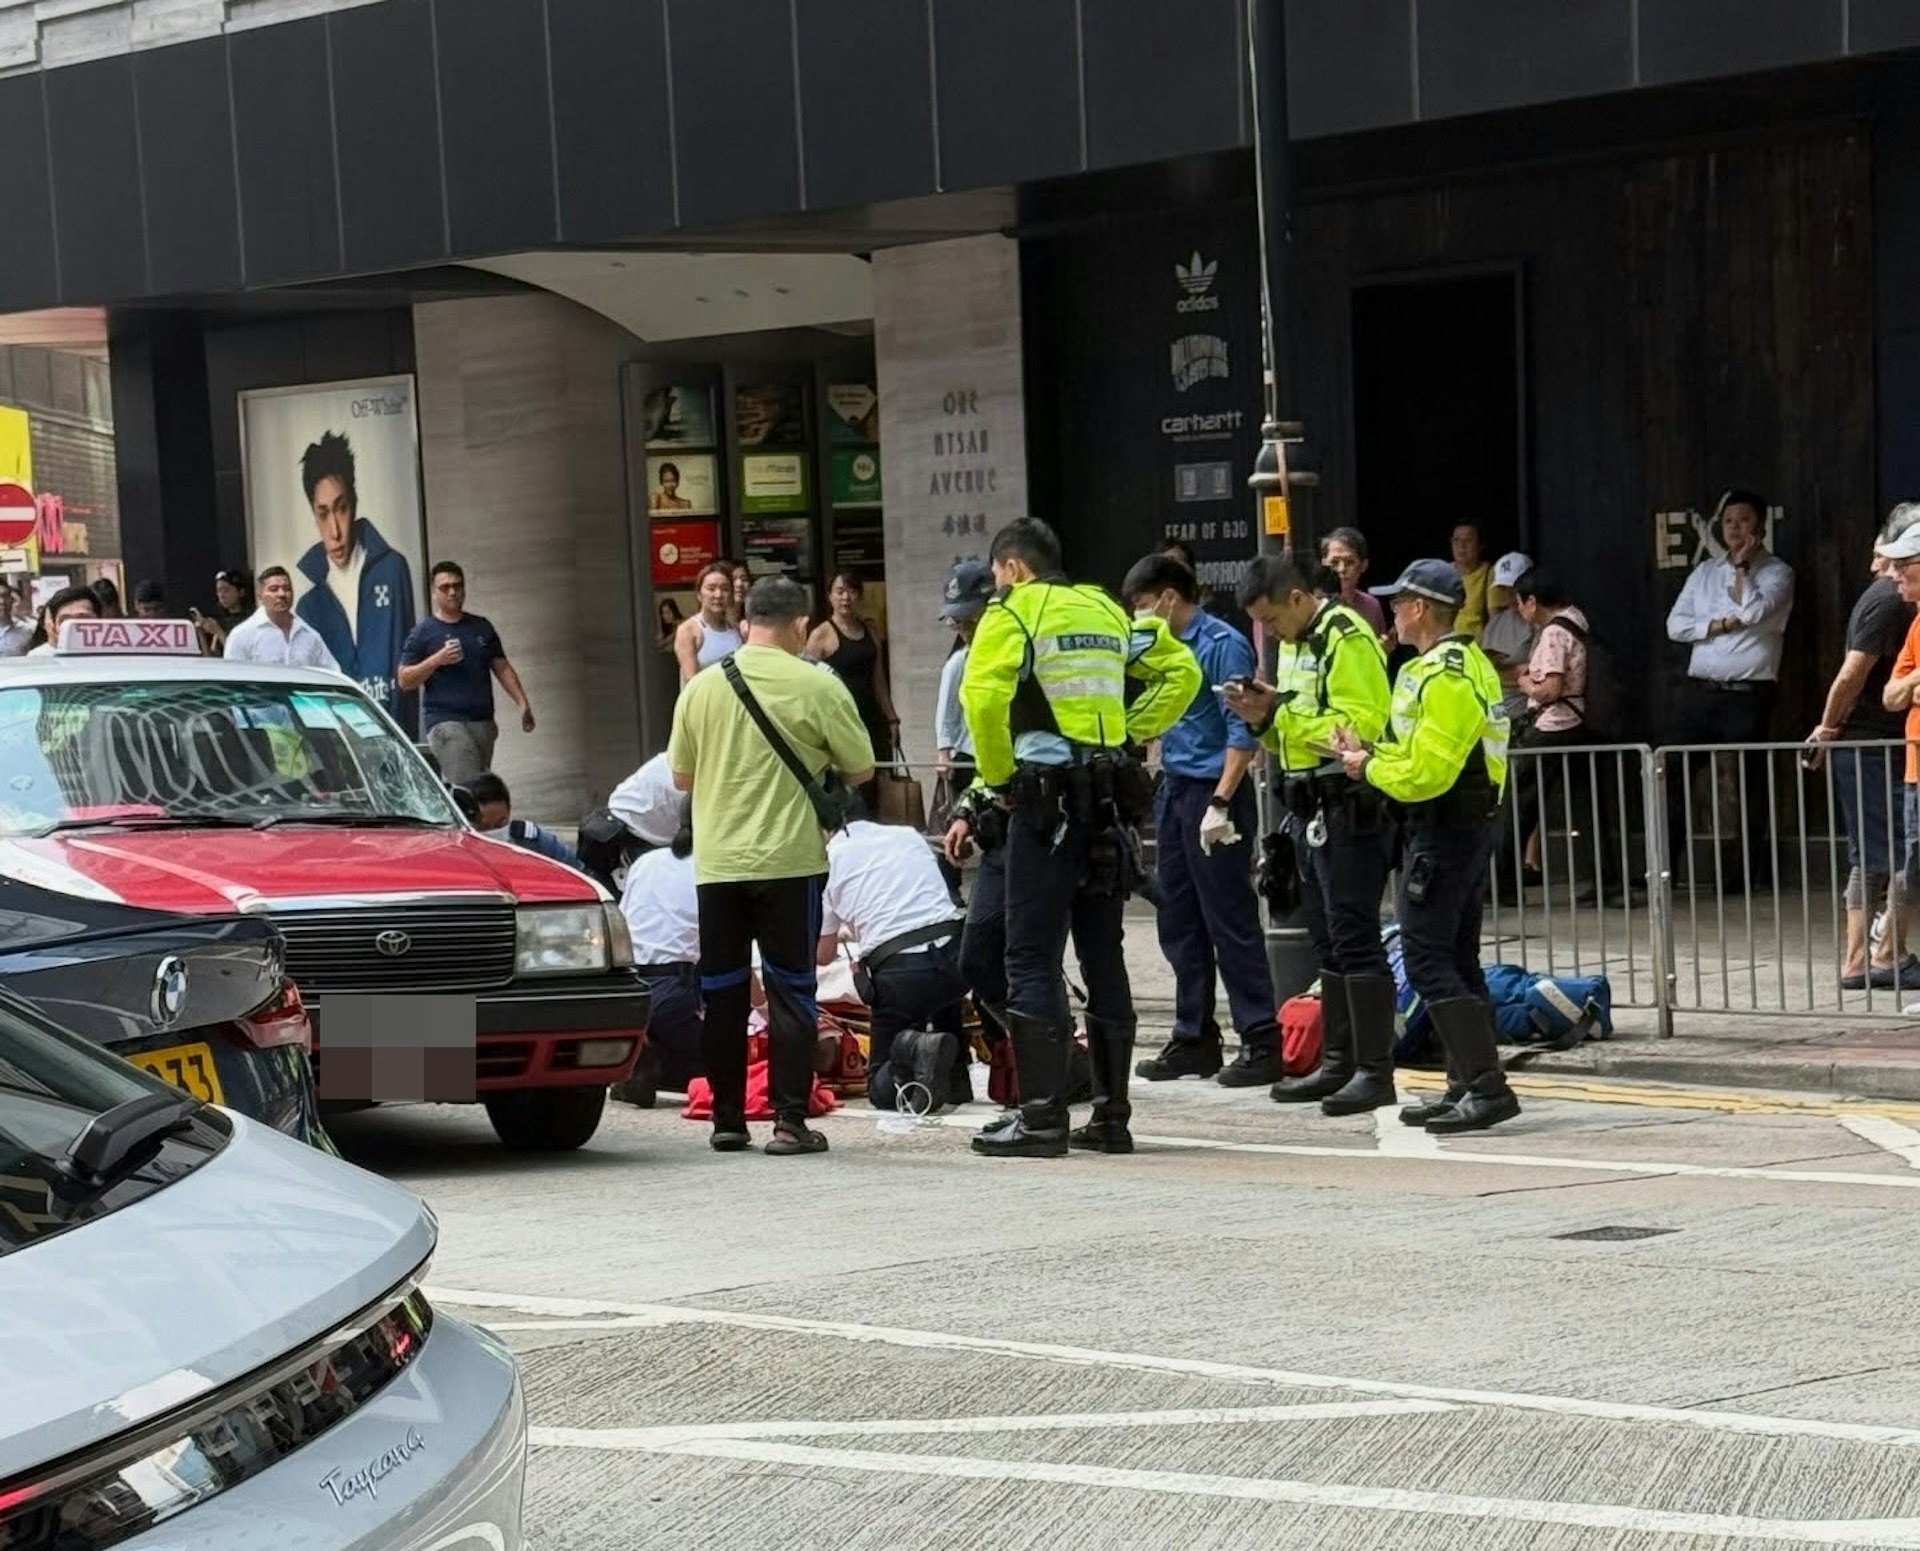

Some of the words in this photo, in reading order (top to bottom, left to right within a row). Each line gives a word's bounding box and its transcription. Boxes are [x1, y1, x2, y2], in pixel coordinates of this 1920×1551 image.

[1161, 410, 1243, 434] carhartt
[1165, 523, 1197, 540] FEAR
[1201, 522, 1217, 539] OF
[1655, 491, 1785, 570] EXT
[76, 623, 187, 647] TAXI
